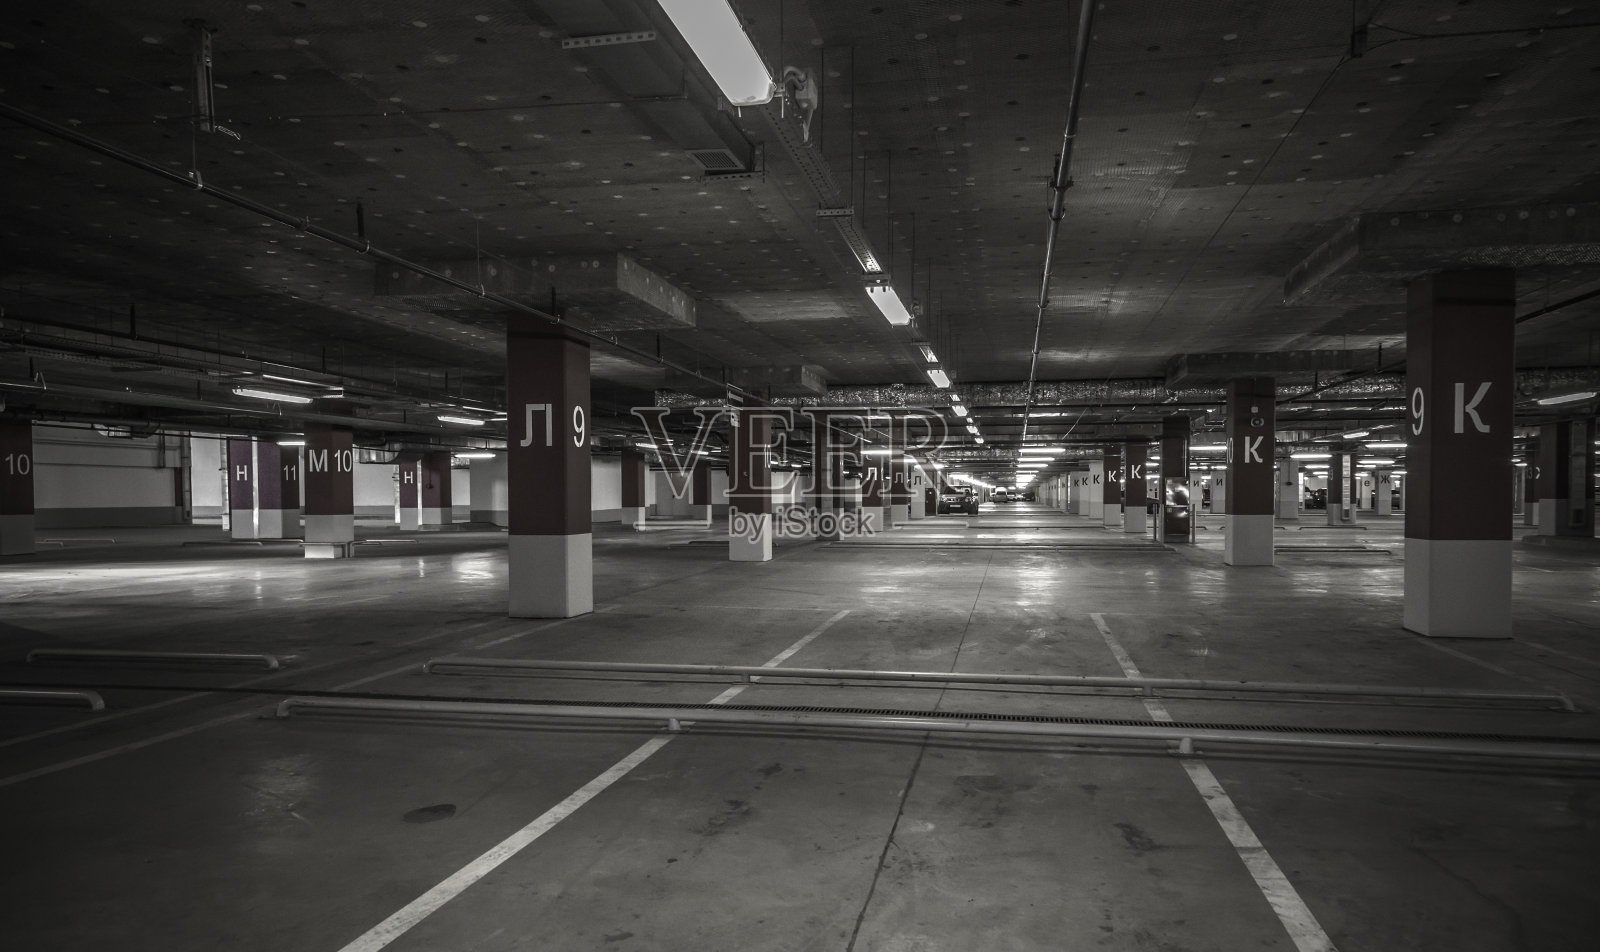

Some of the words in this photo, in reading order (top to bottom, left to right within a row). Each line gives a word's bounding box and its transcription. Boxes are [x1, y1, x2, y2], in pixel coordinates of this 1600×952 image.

[519, 403, 553, 447] Л
[572, 405, 586, 448] 9
[1411, 387, 1425, 436] 9
[4, 452, 31, 476] 10
[282, 465, 297, 481] 11
[333, 448, 353, 473] 10
